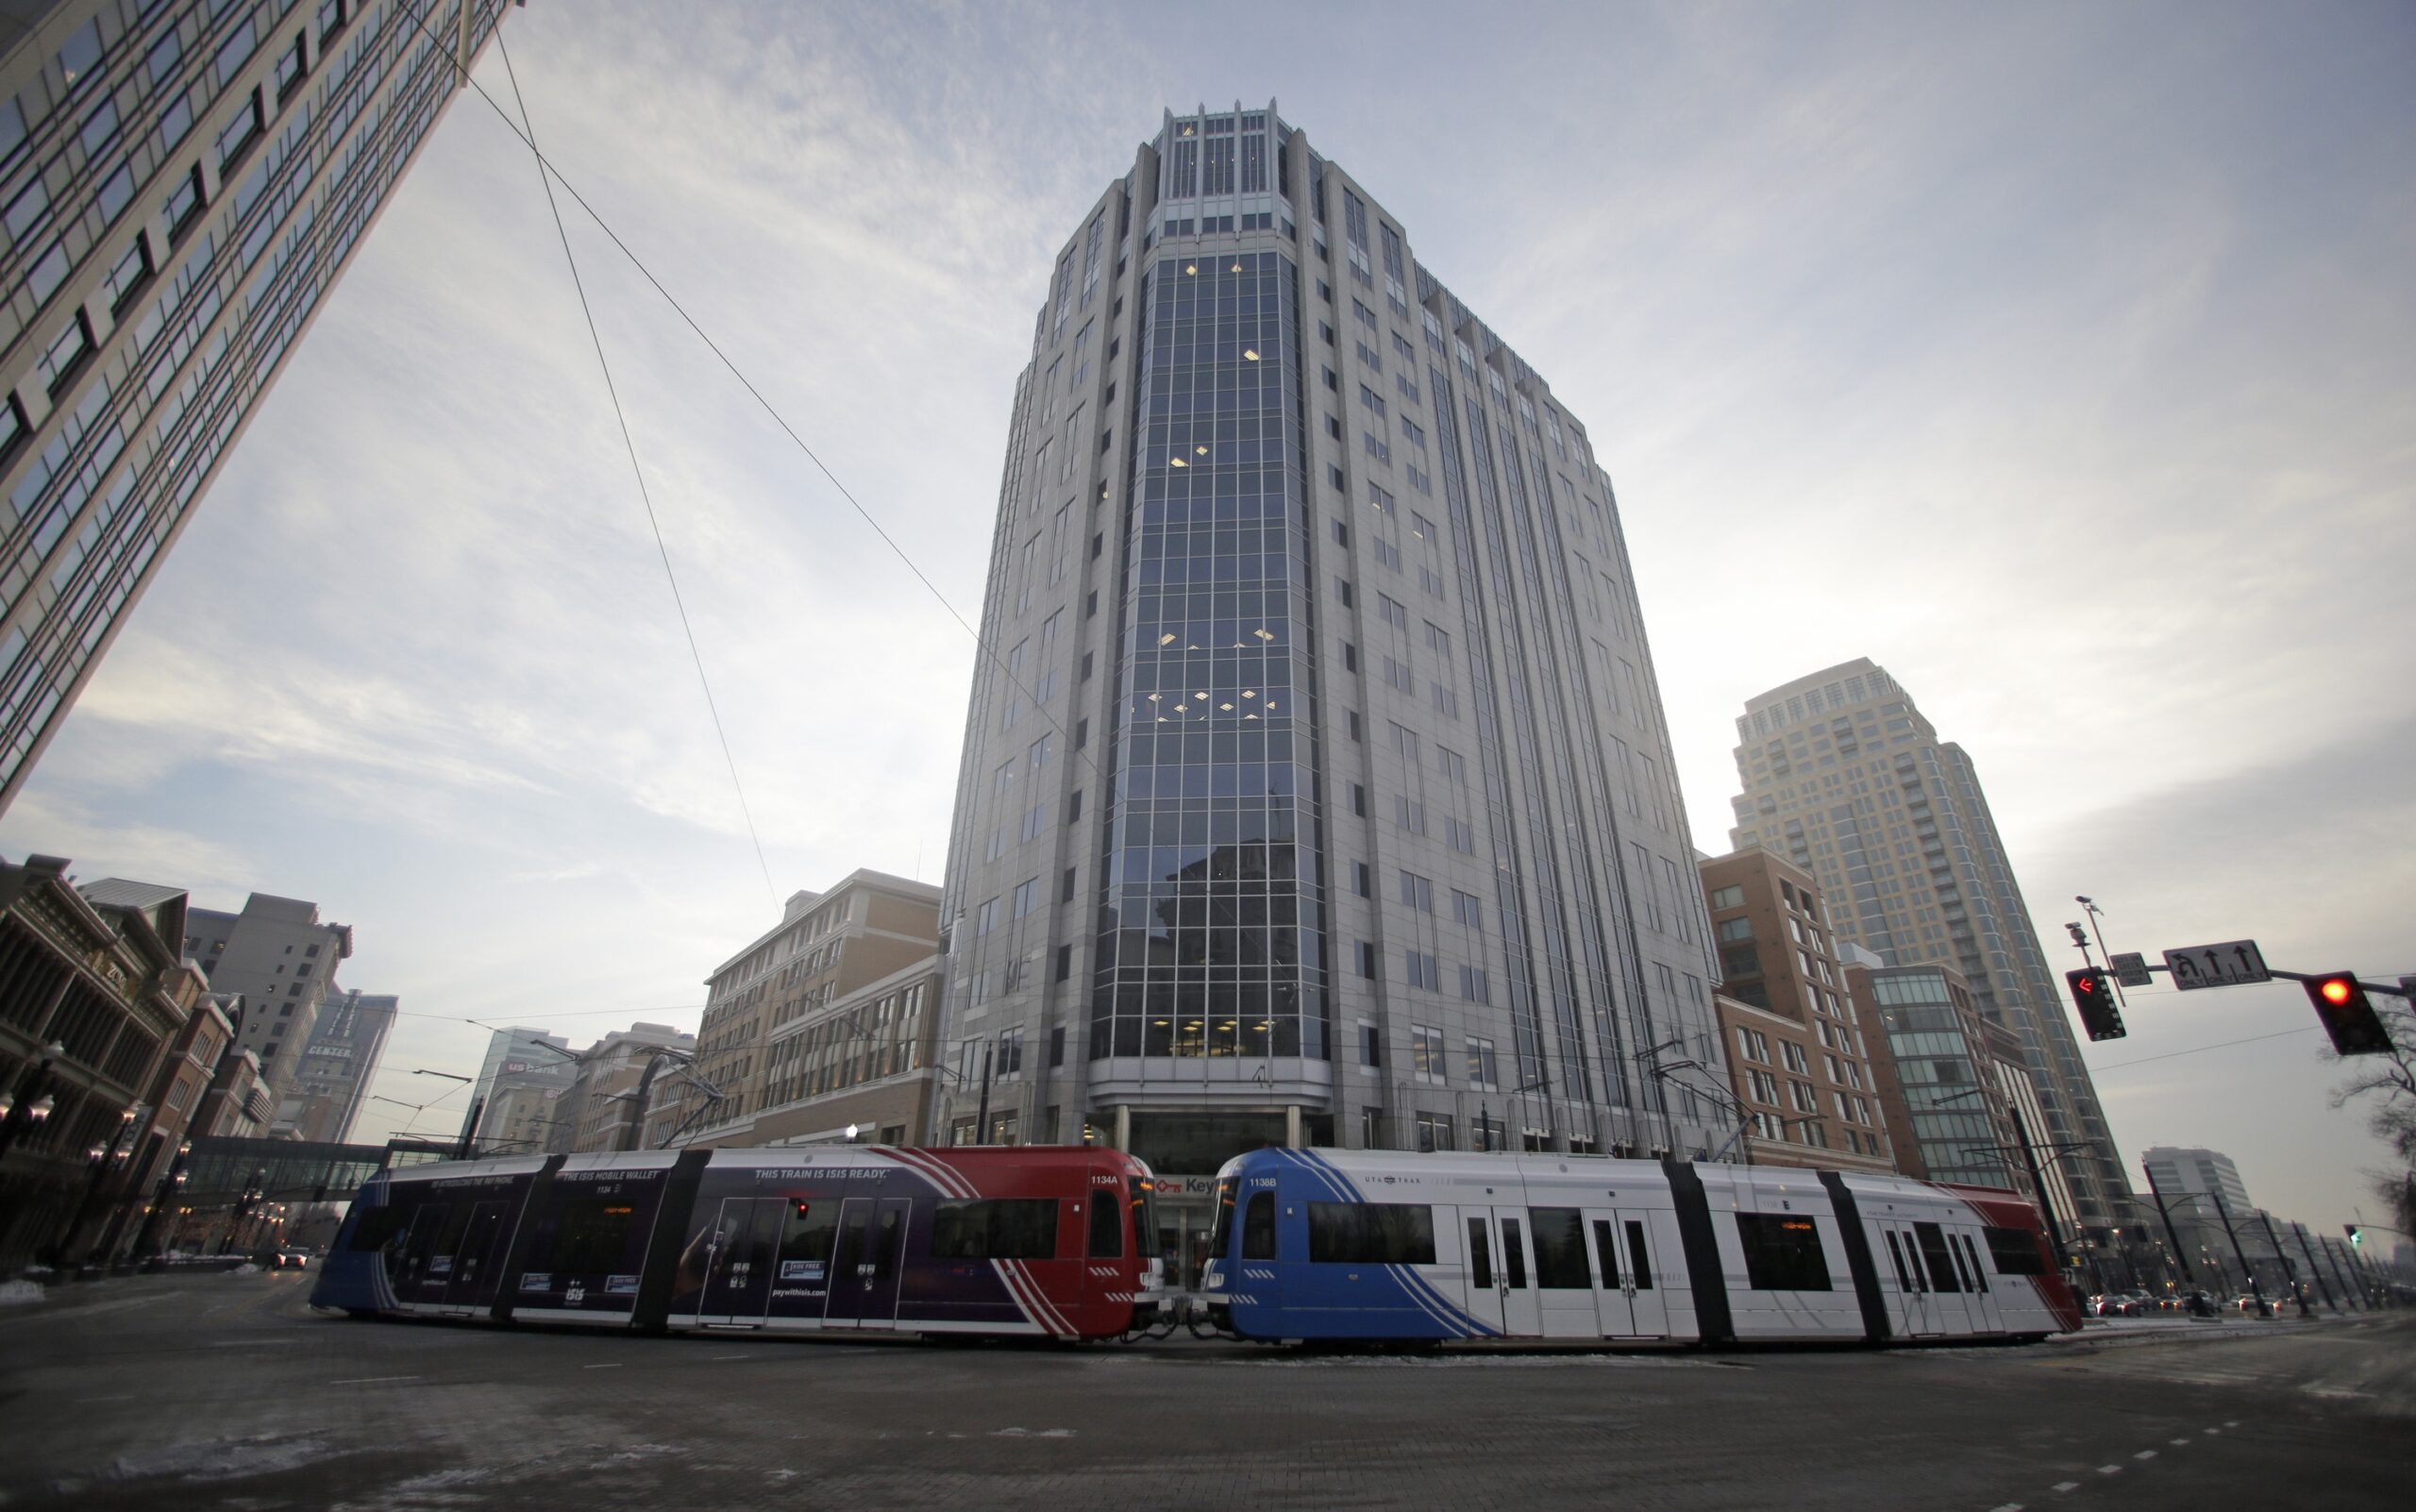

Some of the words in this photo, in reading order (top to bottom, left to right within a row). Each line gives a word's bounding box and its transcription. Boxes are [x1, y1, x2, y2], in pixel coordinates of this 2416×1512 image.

[2238, 972, 2265, 981] ONLY
[308, 1046, 352, 1057] CENTER
[563, 1172, 579, 1182] THE
[579, 1171, 594, 1181] ISIS
[595, 1170, 625, 1180] MOBILE
[626, 1170, 659, 1180] WALLET
[755, 1169, 779, 1179] THIS
[780, 1169, 813, 1179] TRAIN
[814, 1169, 824, 1179] IS
[826, 1169, 847, 1179] ISIS
[1091, 1175, 1118, 1184] 1134A
[1250, 1177, 1277, 1187] 1138B
[1398, 1176, 1420, 1184] TRAX
[1185, 1178, 1215, 1196] Key
[772, 1288, 827, 1298] paywithisis.com
